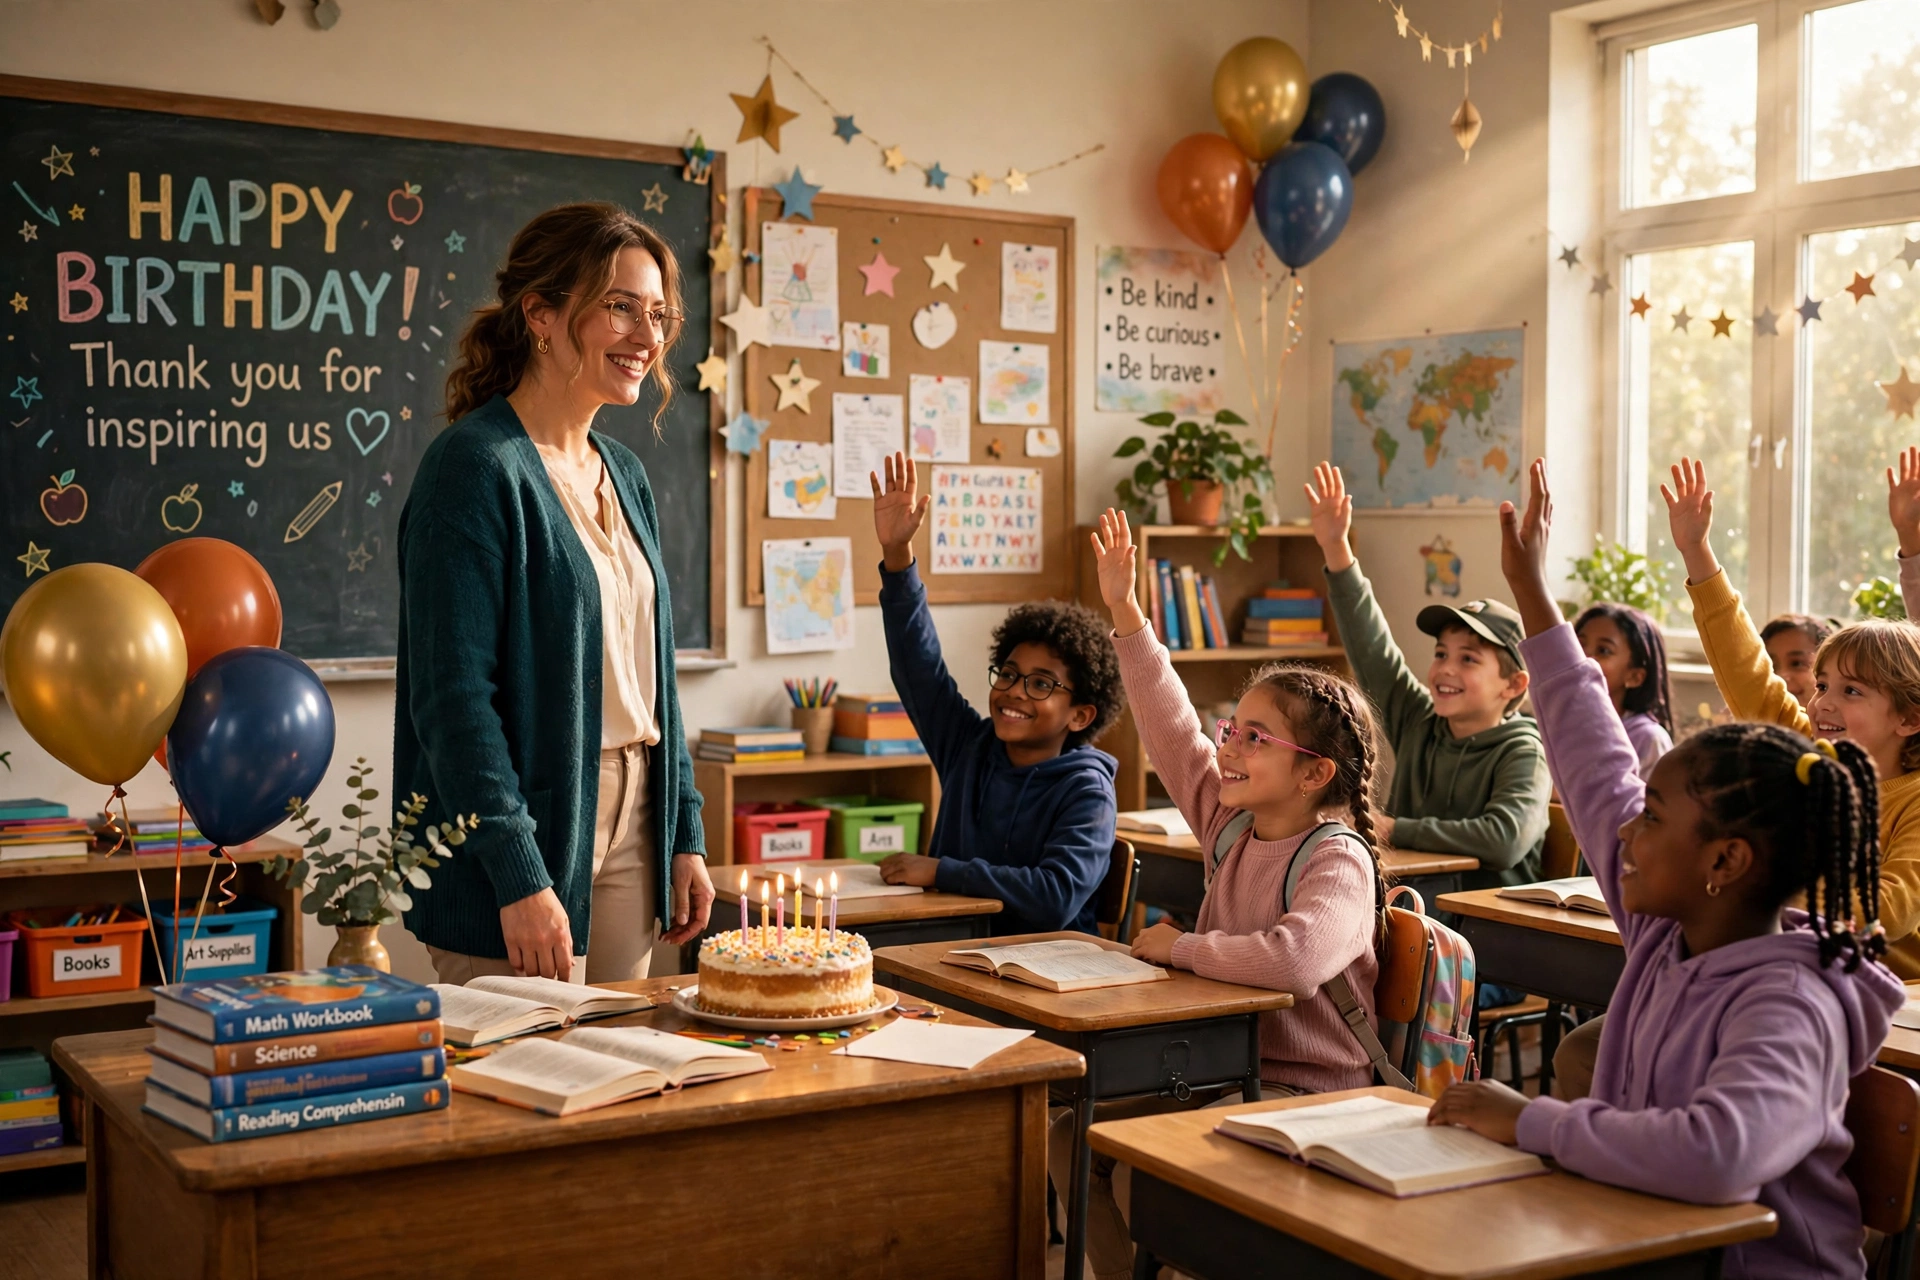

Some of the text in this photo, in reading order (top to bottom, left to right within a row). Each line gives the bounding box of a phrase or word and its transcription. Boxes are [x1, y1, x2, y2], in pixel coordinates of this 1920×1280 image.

[128, 171, 354, 254] HAPPY
[56, 251, 420, 341] BIRTHDAY!
[1121, 277, 1199, 311] Be kind
[1116, 314, 1210, 347] Be curious
[69, 340, 382, 408] Thank you for
[1119, 352, 1203, 383] Be brave
[85, 405, 333, 468] inspiring us
[768, 837, 803, 852] Books
[63, 954, 111, 972] Books
[185, 945, 204, 961] Art
[245, 1013, 288, 1035] Math
[291, 1004, 374, 1029] Workbook
[254, 1043, 318, 1065] Science
[237, 1108, 300, 1132] Reading
[302, 1091, 406, 1123] Comprehensin
